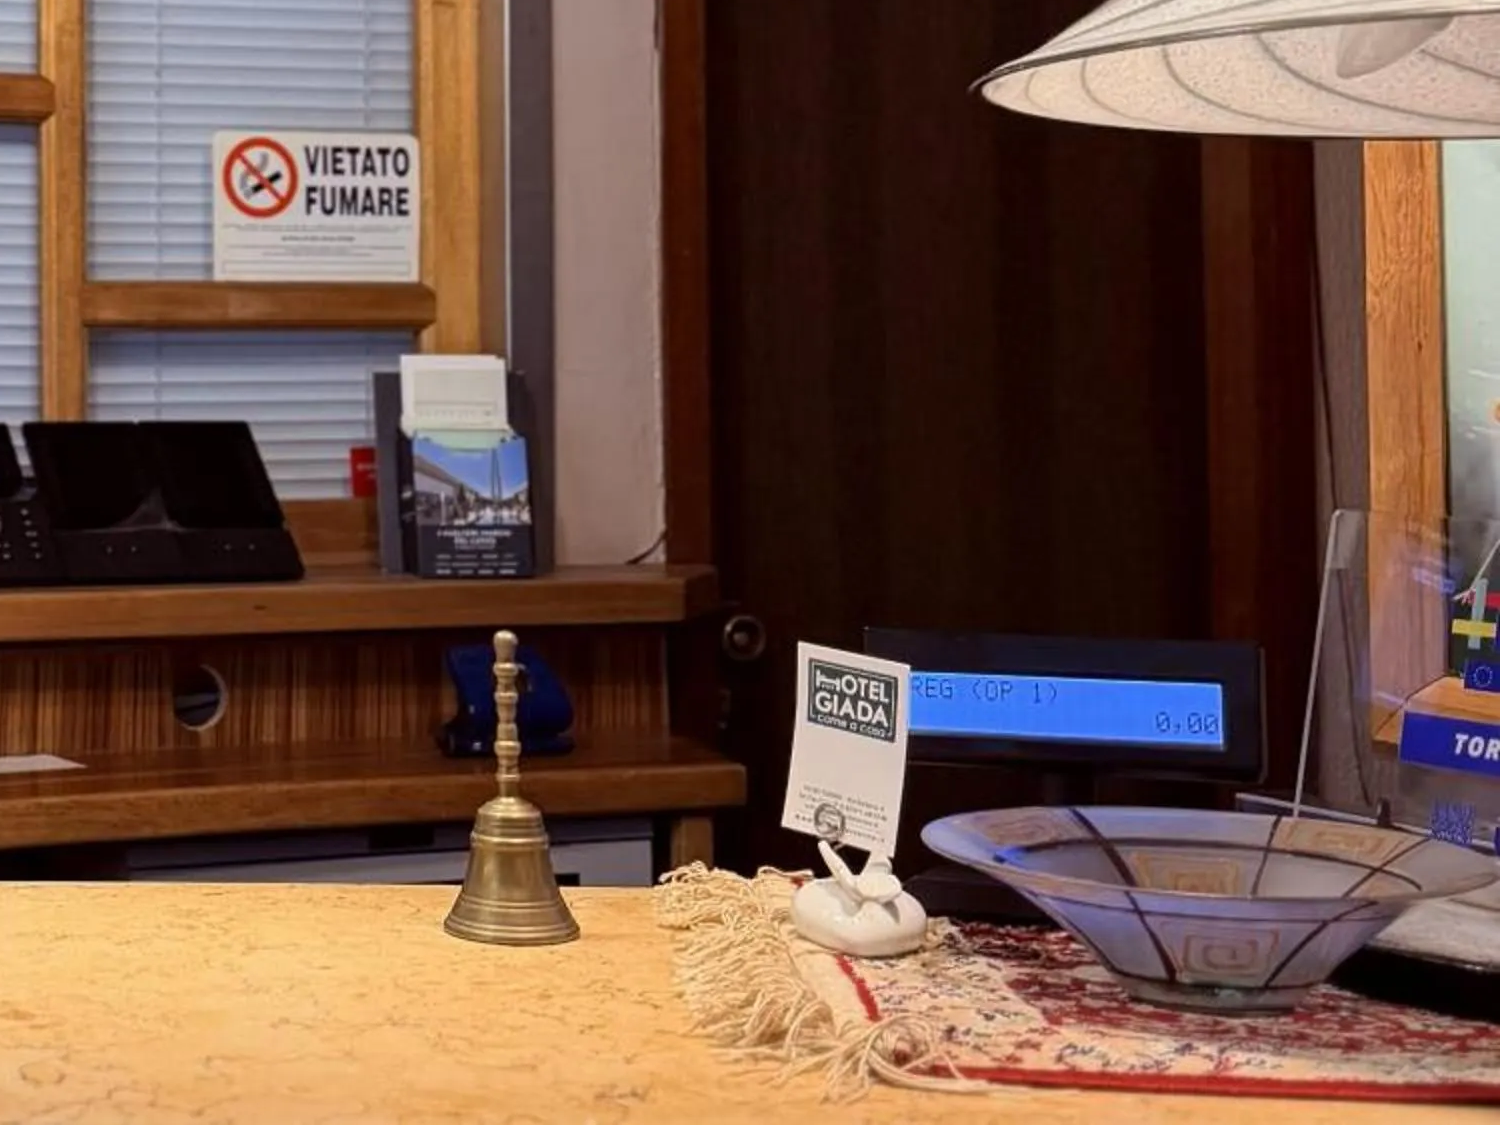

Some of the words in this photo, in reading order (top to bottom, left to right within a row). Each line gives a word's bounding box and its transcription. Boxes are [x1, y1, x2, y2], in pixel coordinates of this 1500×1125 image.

[304, 145, 410, 177] VIETATO
[305, 186, 410, 216] FUMARE
[816, 669, 889, 703] HOTEL
[912, 677, 953, 700] REG
[815, 691, 888, 727] GIADA
